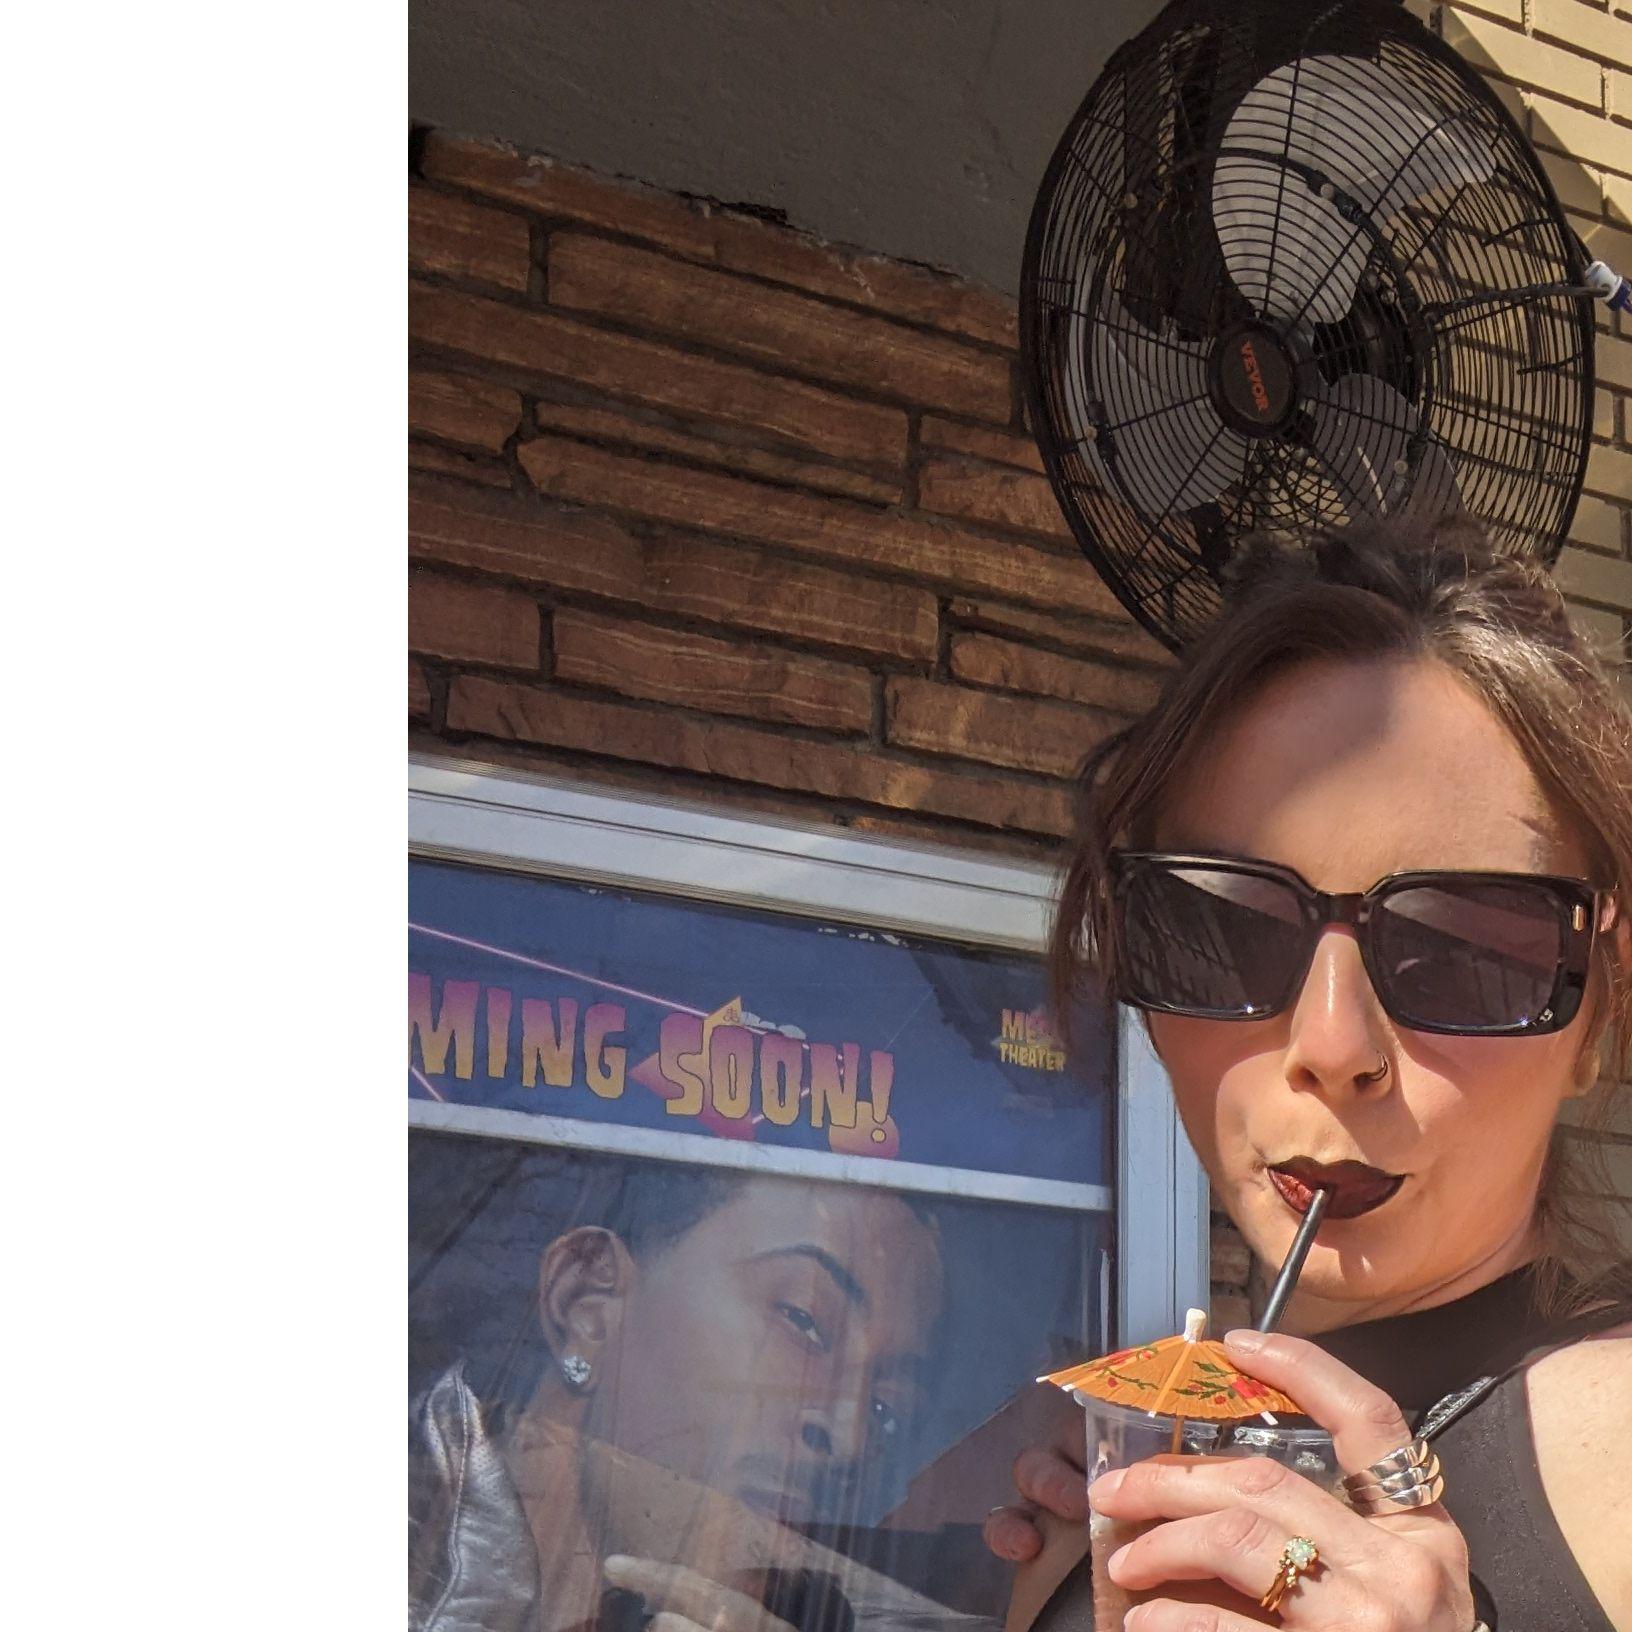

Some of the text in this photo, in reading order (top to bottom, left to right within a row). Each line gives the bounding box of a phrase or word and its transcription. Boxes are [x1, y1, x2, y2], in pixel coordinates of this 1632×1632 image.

[408, 971, 894, 1143] MING SOON!
[999, 1042, 1066, 1072] THEATER
